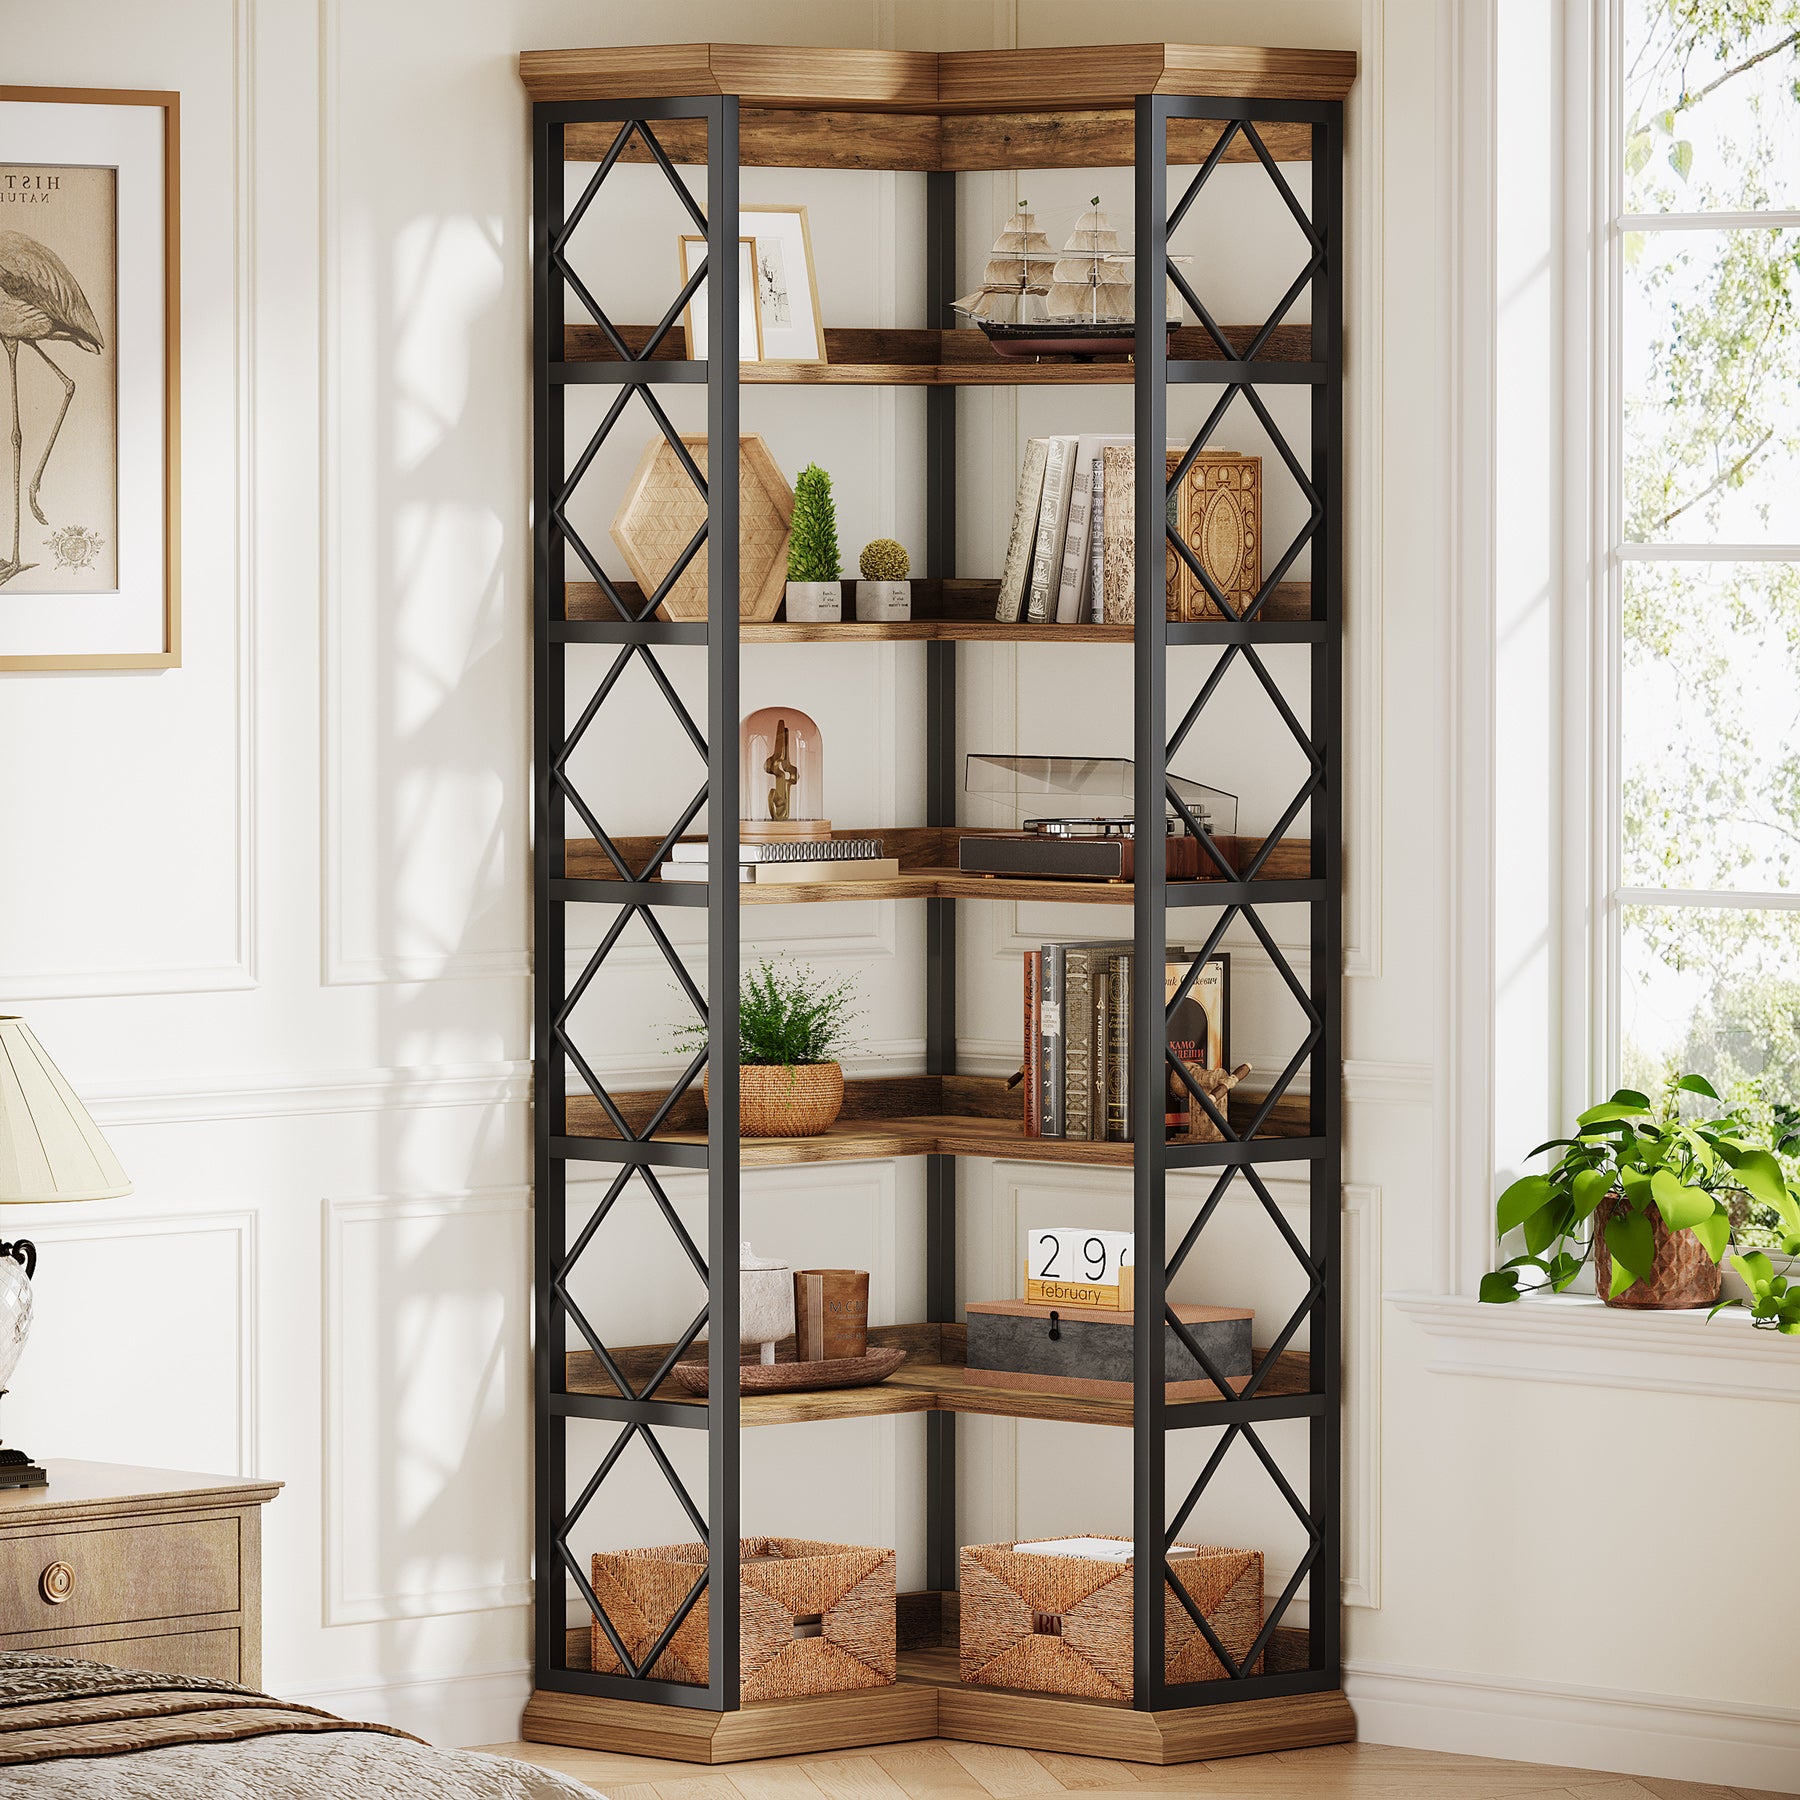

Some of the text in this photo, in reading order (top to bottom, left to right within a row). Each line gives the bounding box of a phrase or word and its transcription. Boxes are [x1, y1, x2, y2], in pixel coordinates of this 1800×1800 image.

[1169, 1040, 1196, 1050] КАМО
[1174, 1049, 1204, 1059] ДЕШИ
[1040, 1281, 1102, 1305] february
